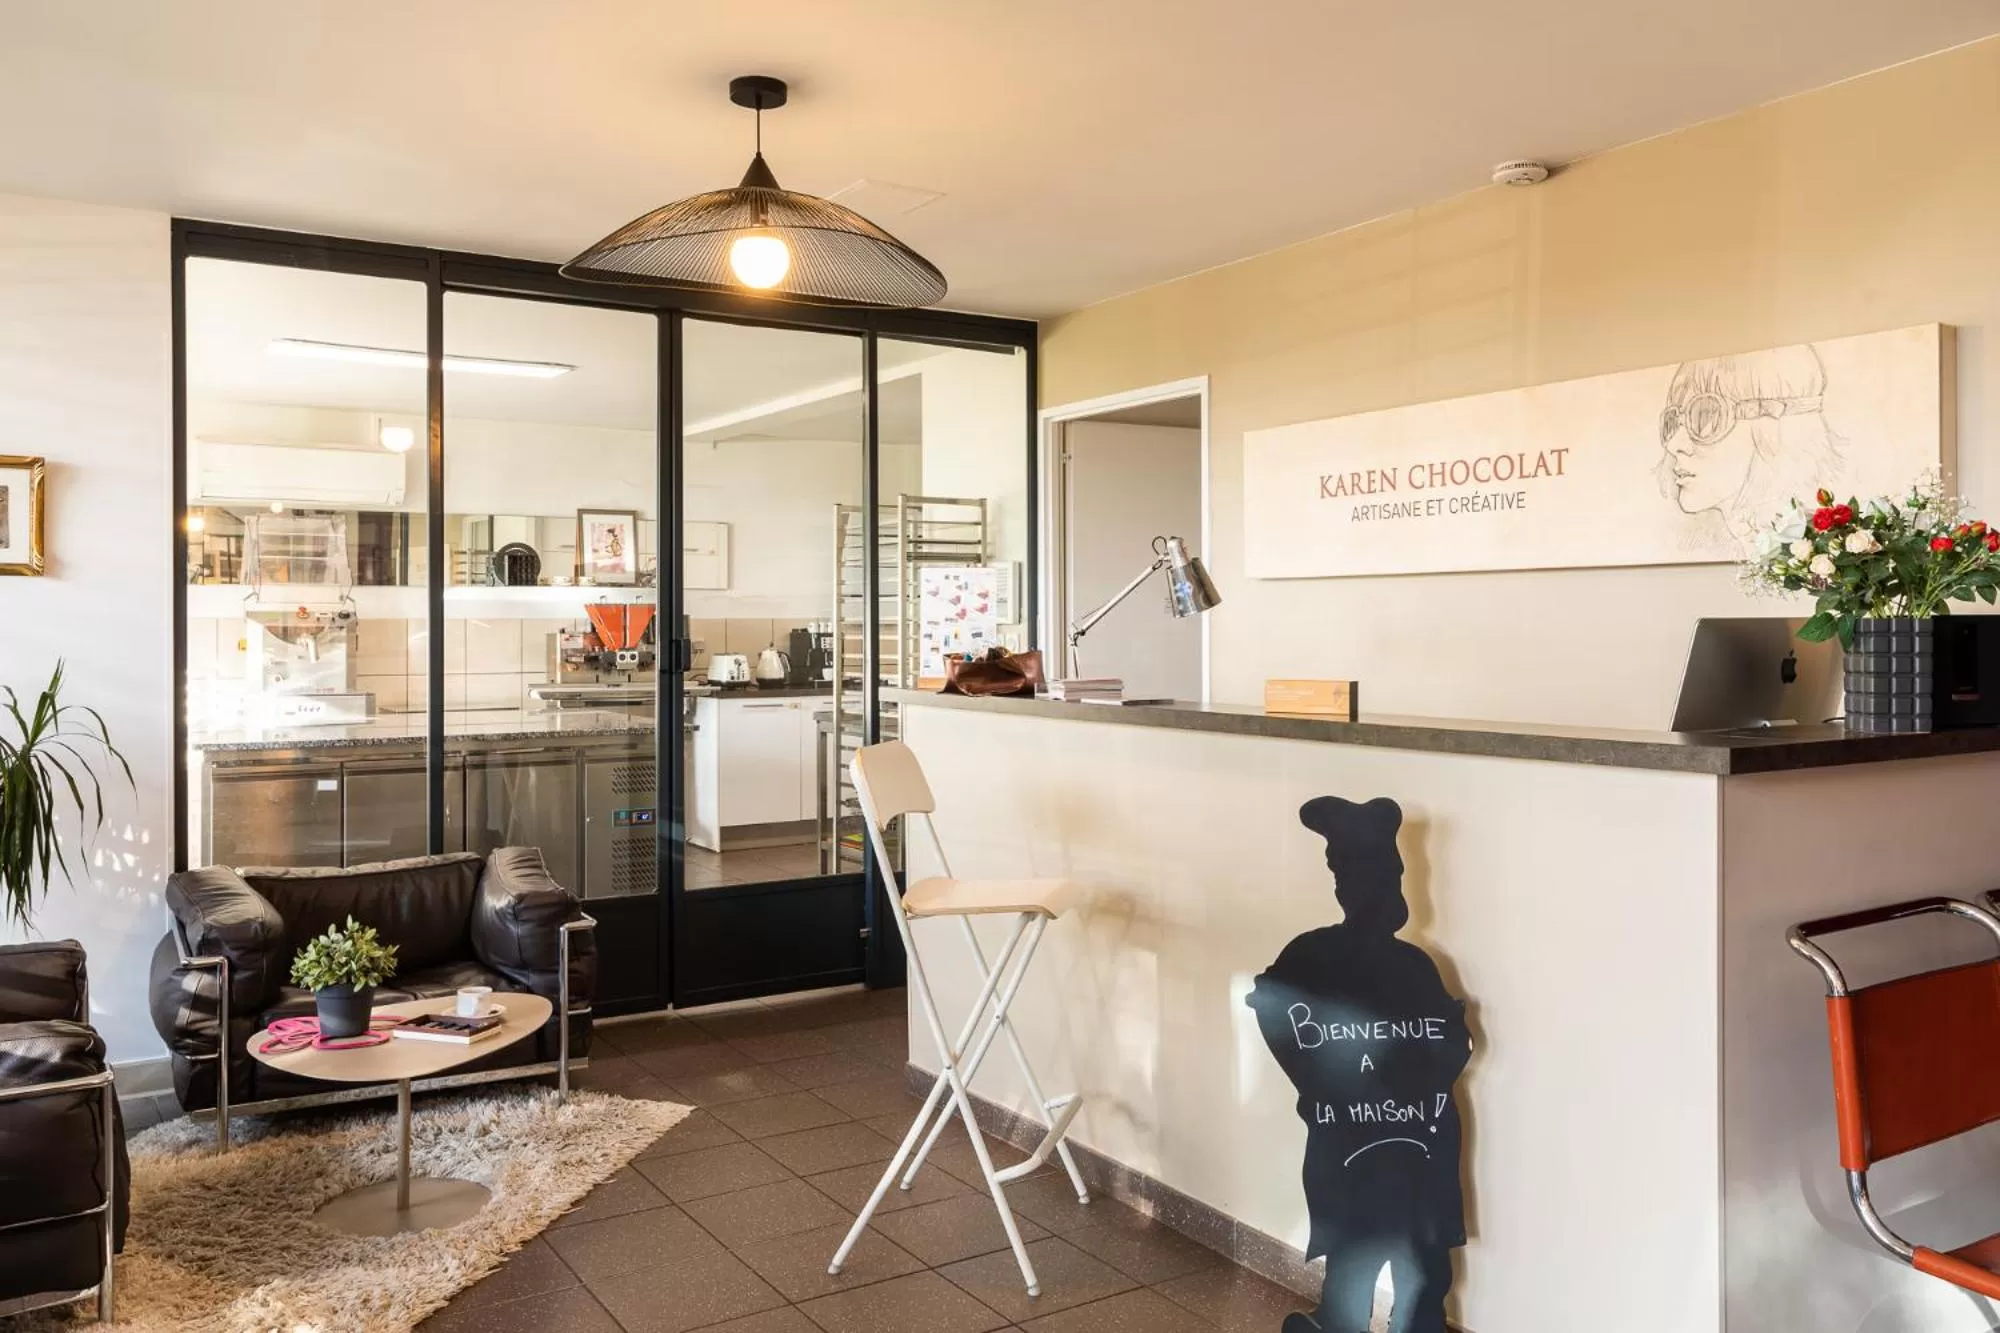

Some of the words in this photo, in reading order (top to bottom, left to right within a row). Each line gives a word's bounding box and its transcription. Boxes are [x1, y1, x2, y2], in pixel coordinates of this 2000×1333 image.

[1320, 468, 1398, 499] KAREN
[1408, 448, 1569, 490] CHOCOLAT
[1352, 501, 1422, 522] ARTISANE
[1426, 499, 1445, 517] ET
[1449, 491, 1526, 515] CRÉATIVE
[1287, 1002, 1447, 1050] BIENVENUE
[1360, 1053, 1375, 1073] A
[1315, 1101, 1336, 1124] LA
